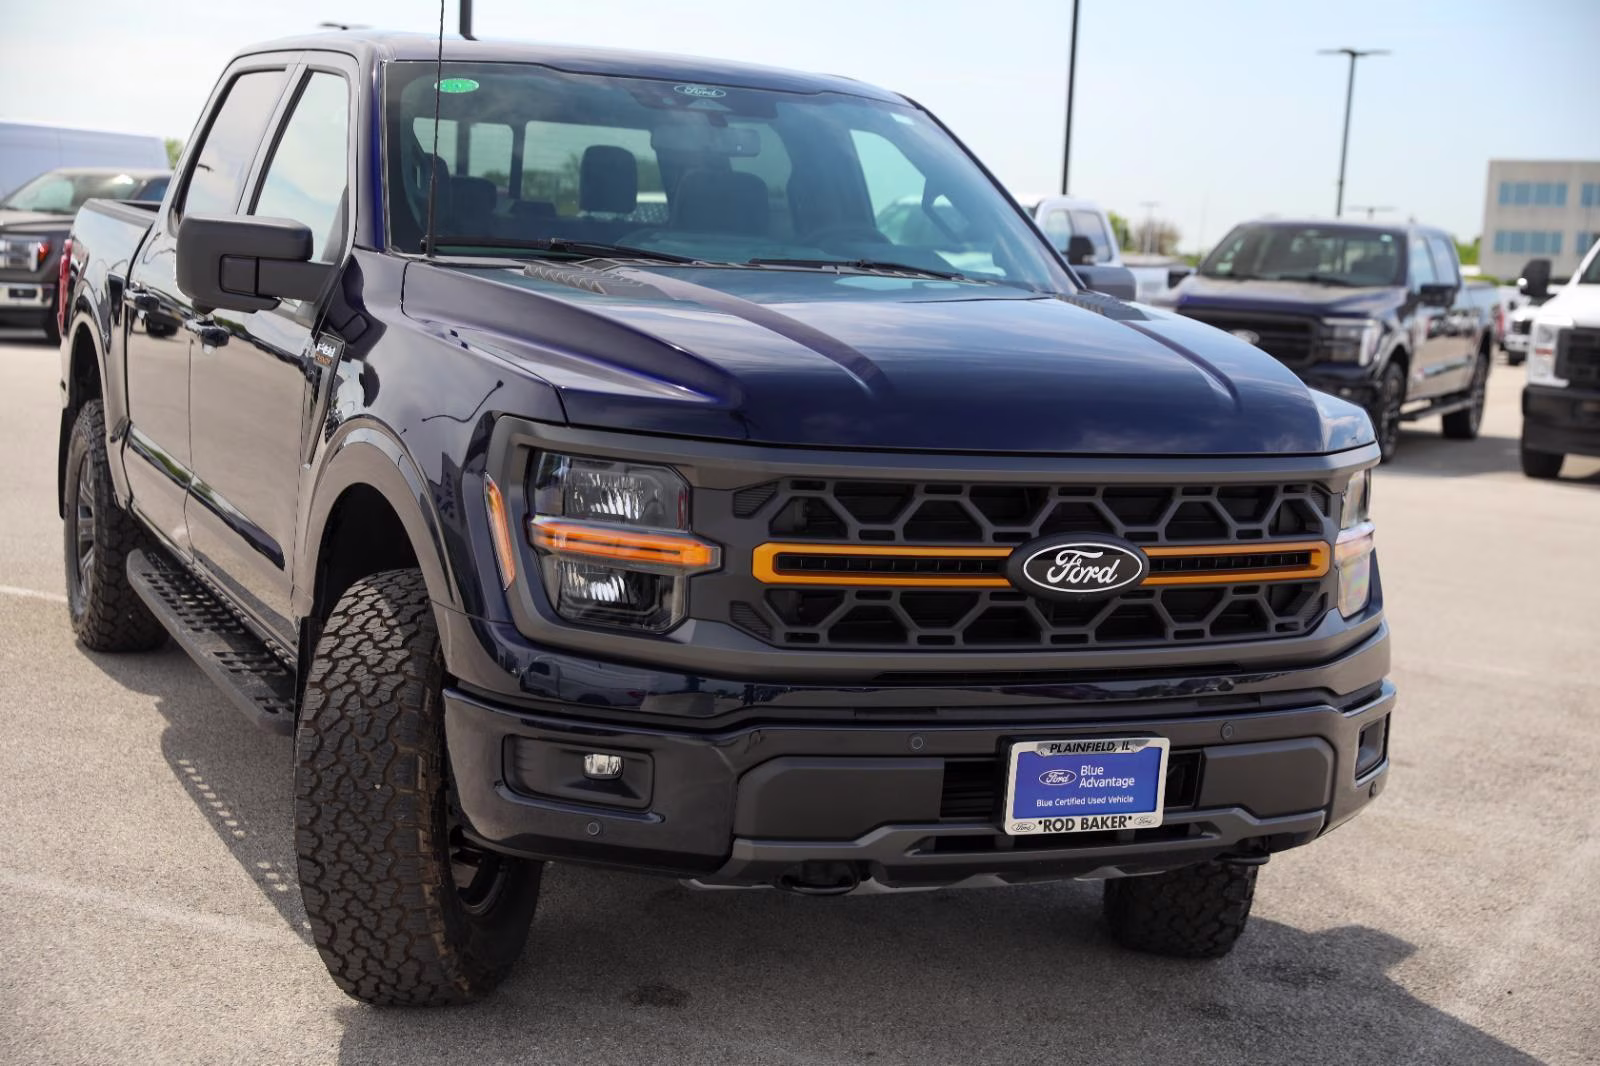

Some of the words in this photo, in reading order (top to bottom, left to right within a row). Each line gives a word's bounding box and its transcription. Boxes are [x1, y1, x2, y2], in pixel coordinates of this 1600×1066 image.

[1046, 549, 1121, 584] Ford
[1049, 742, 1118, 754] PLAINFIELD,
[1121, 741, 1131, 751] IL
[1080, 765, 1104, 776] Blue
[1044, 771, 1070, 784] Ford
[1079, 776, 1135, 789] Advantage
[1036, 799, 1053, 807] Blue
[1054, 796, 1086, 806] Certified
[1087, 796, 1106, 805] Used
[1107, 795, 1134, 804] Vehicle
